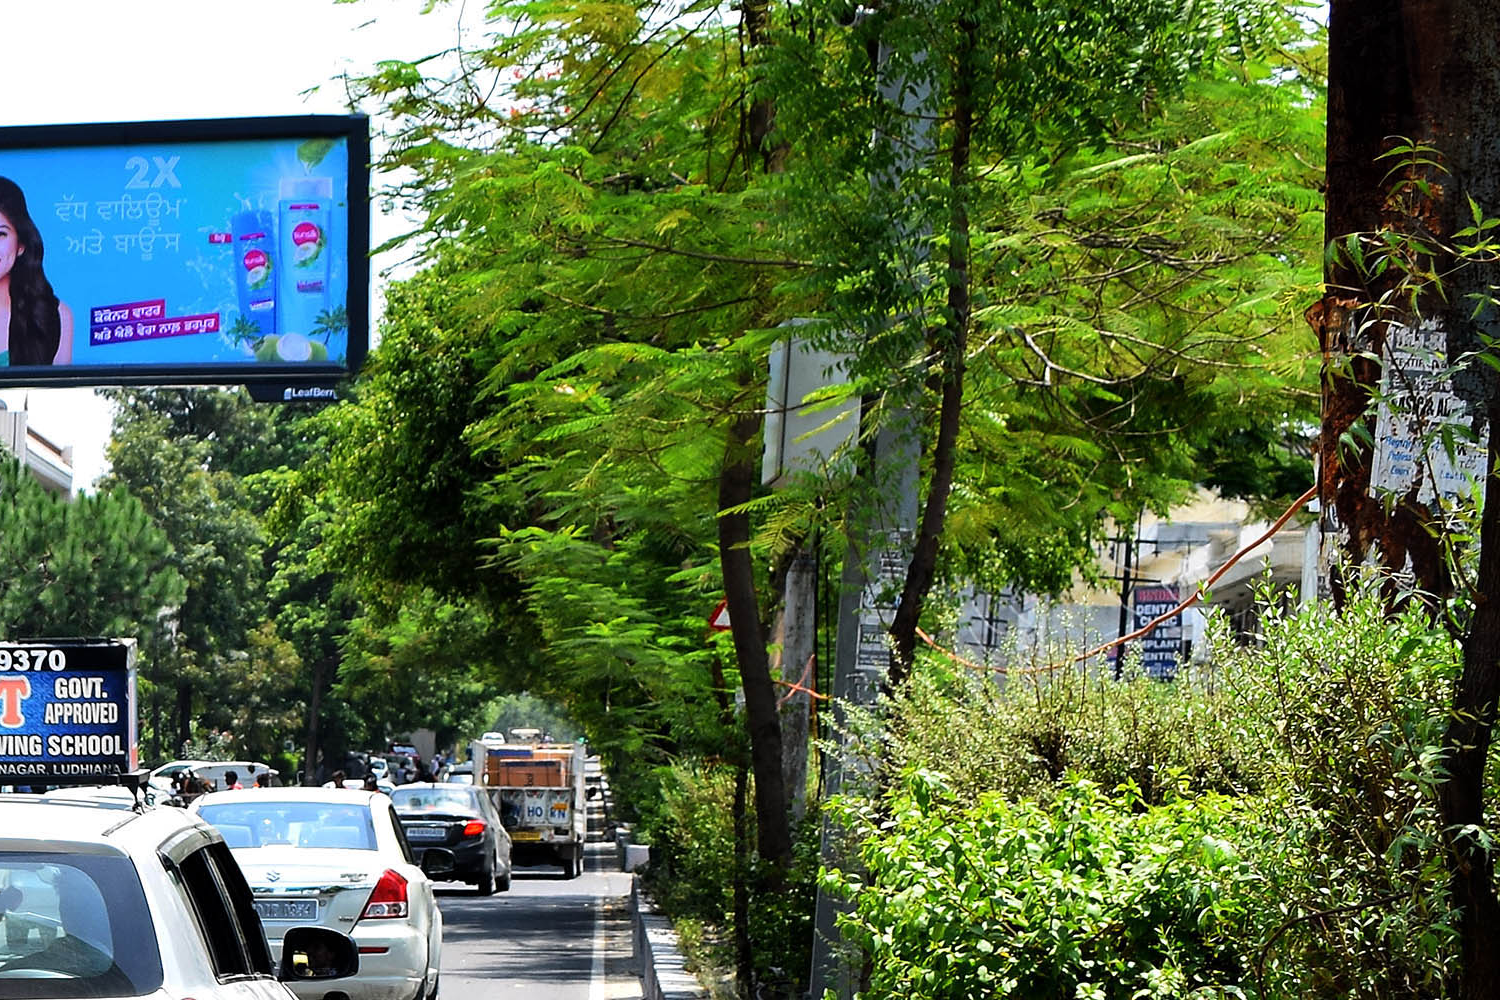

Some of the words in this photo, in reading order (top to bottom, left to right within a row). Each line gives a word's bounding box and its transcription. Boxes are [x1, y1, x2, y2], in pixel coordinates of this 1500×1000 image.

[125, 156, 181, 189] 2X
[54, 677, 108, 699] GOVT.
[44, 702, 118, 724] APPROVED
[47, 734, 125, 756] SCHOOL
[53, 764, 122, 776] LUDHIANA
